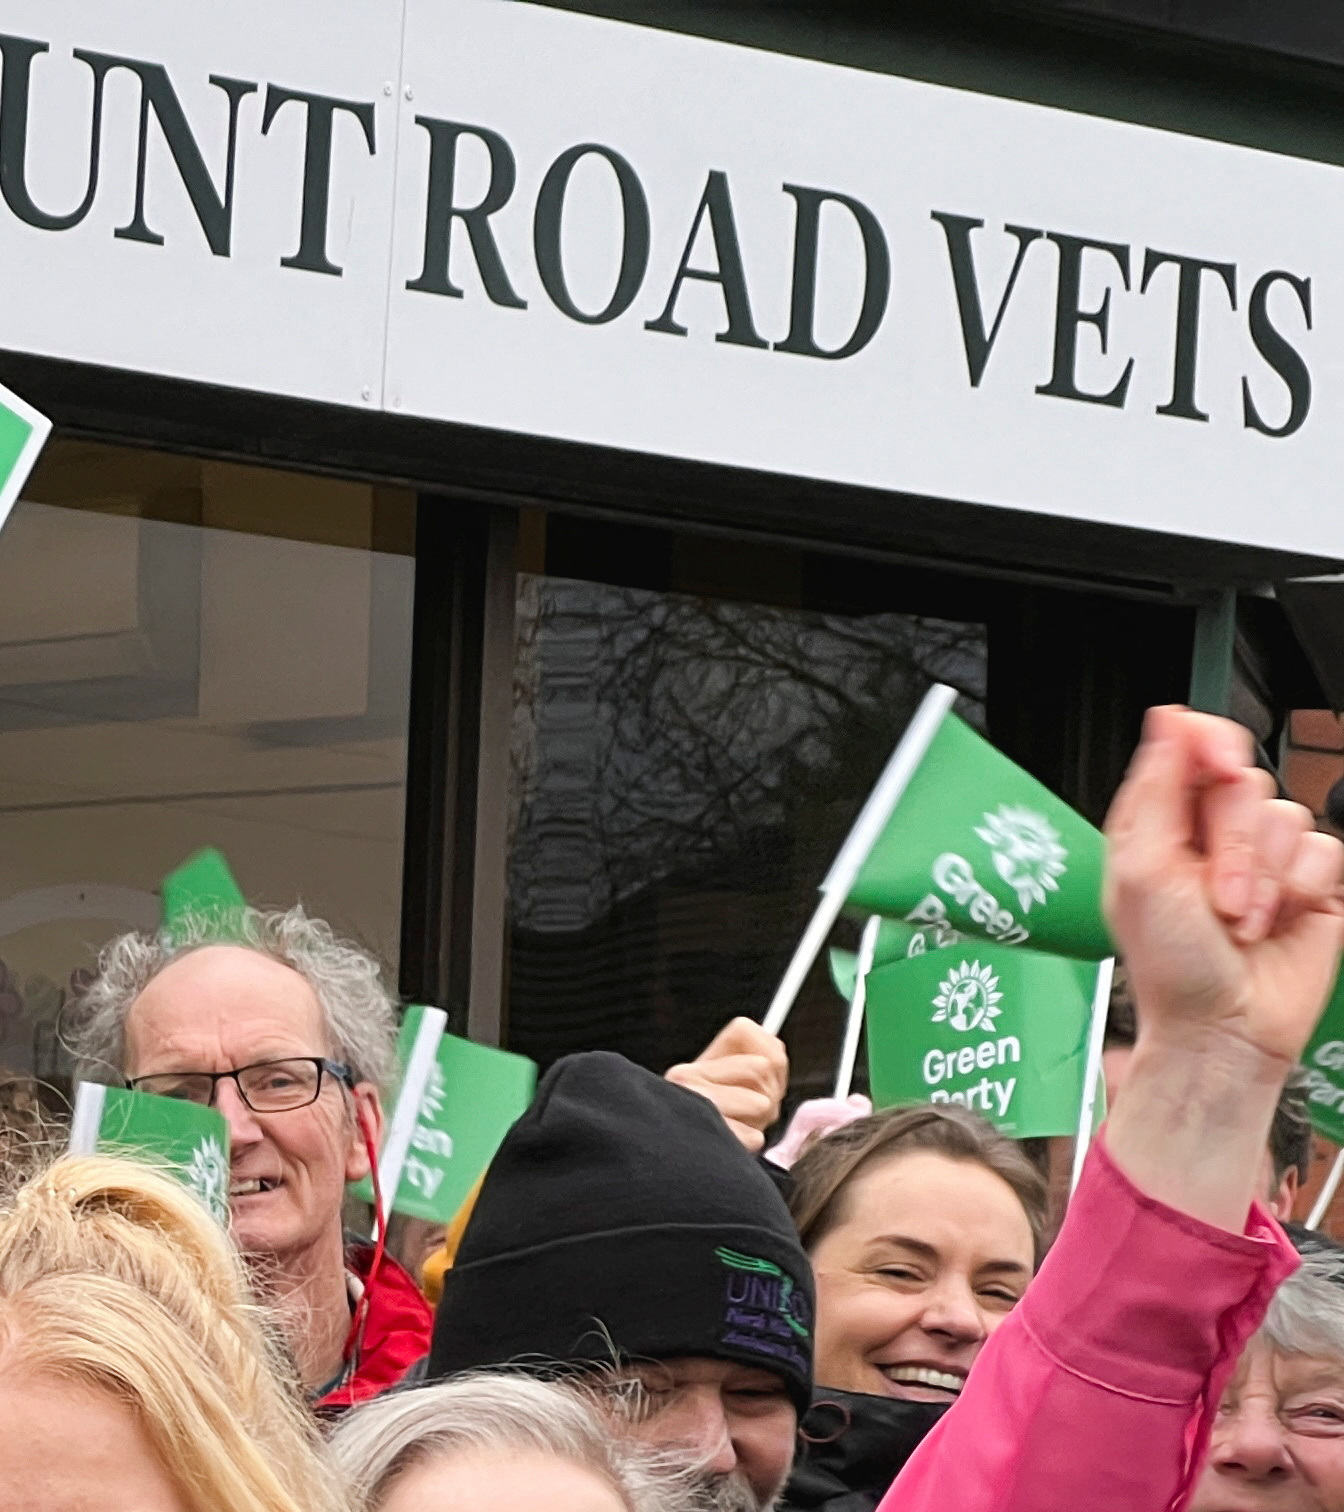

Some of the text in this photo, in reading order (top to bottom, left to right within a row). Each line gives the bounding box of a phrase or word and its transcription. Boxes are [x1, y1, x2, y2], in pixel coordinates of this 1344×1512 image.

[404, 114, 892, 361] ROAD
[931, 210, 1314, 438] VETS
[932, 852, 1029, 944] Green
[923, 1036, 1021, 1085] Green
